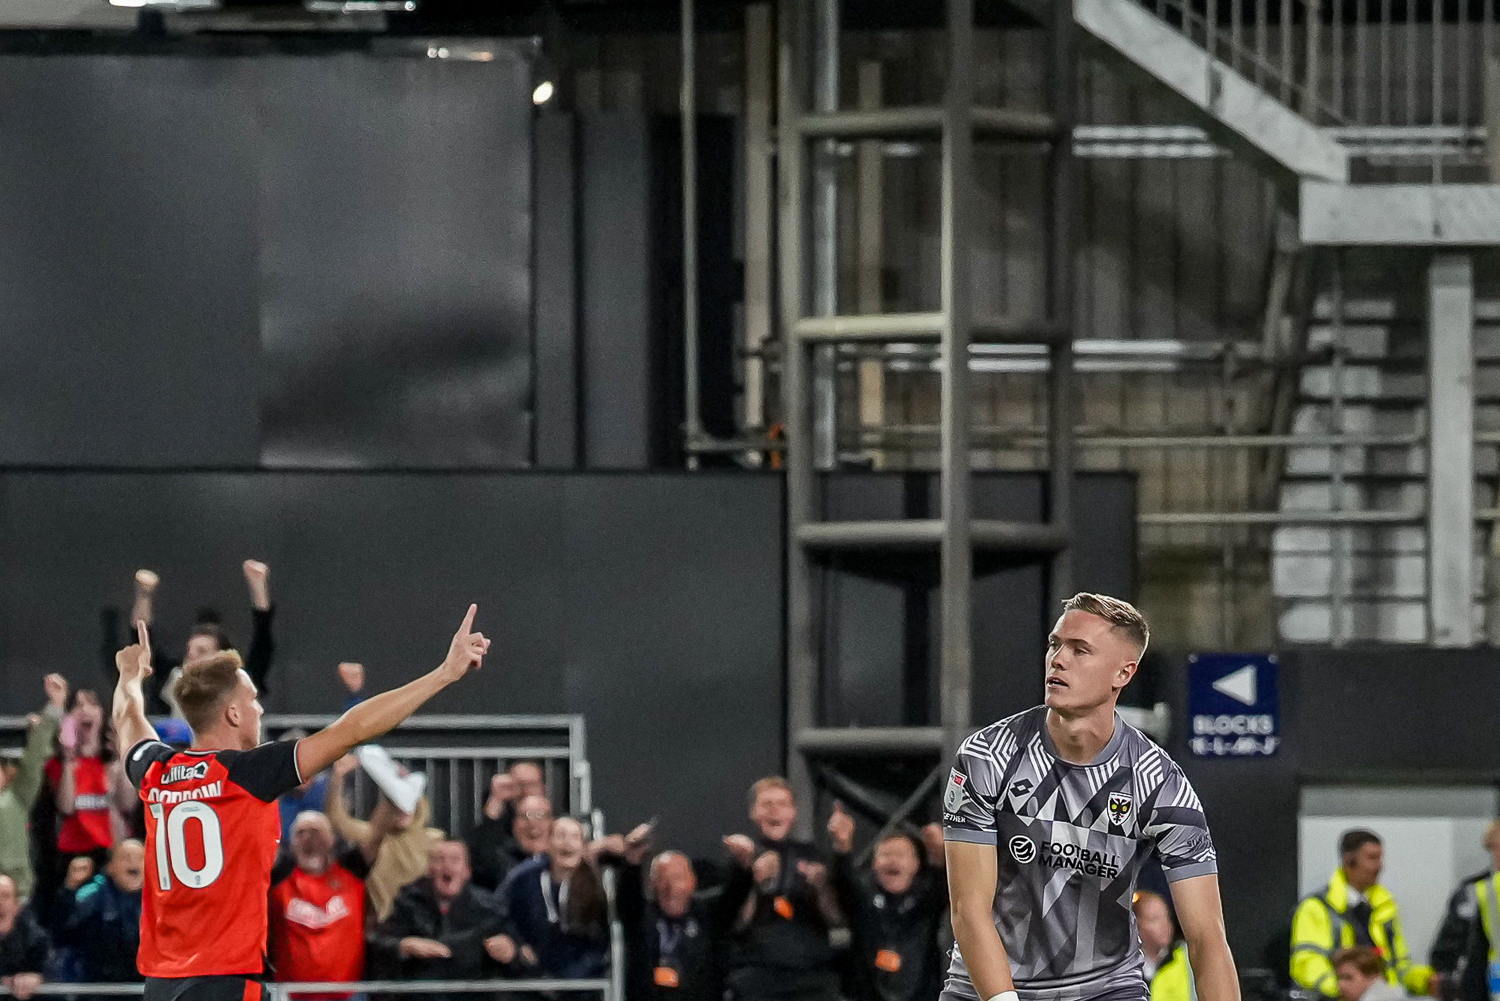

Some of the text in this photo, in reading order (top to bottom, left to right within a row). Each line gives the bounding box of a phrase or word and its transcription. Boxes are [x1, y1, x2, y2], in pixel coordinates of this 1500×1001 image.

[1193, 714, 1274, 735] BLOCKS
[148, 800, 224, 890] 10
[1041, 841, 1118, 868] FOOTBALL
[1038, 854, 1117, 880] MANAGER
